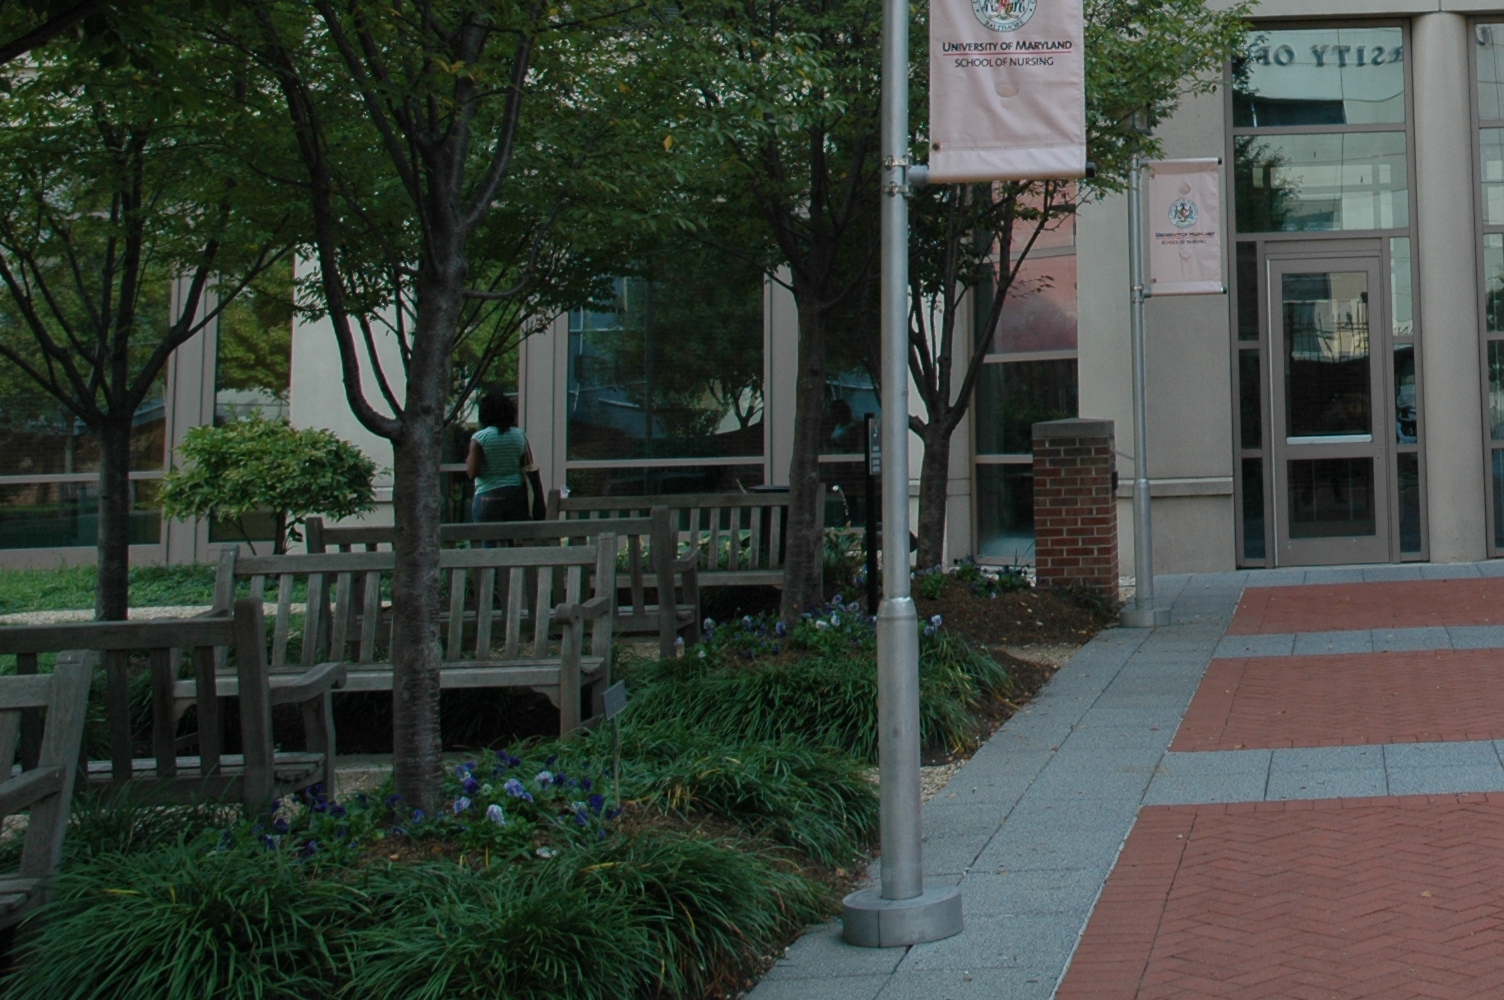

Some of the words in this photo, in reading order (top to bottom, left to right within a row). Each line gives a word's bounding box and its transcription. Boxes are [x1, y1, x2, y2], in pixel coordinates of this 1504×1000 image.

[943, 42, 998, 52] UNIVERSITY
[1000, 42, 1013, 51] OF
[1015, 41, 1072, 51] MARYLAND
[955, 58, 993, 68] SCHOOL
[995, 58, 1007, 67] OF
[1009, 57, 1054, 67] NURSING
